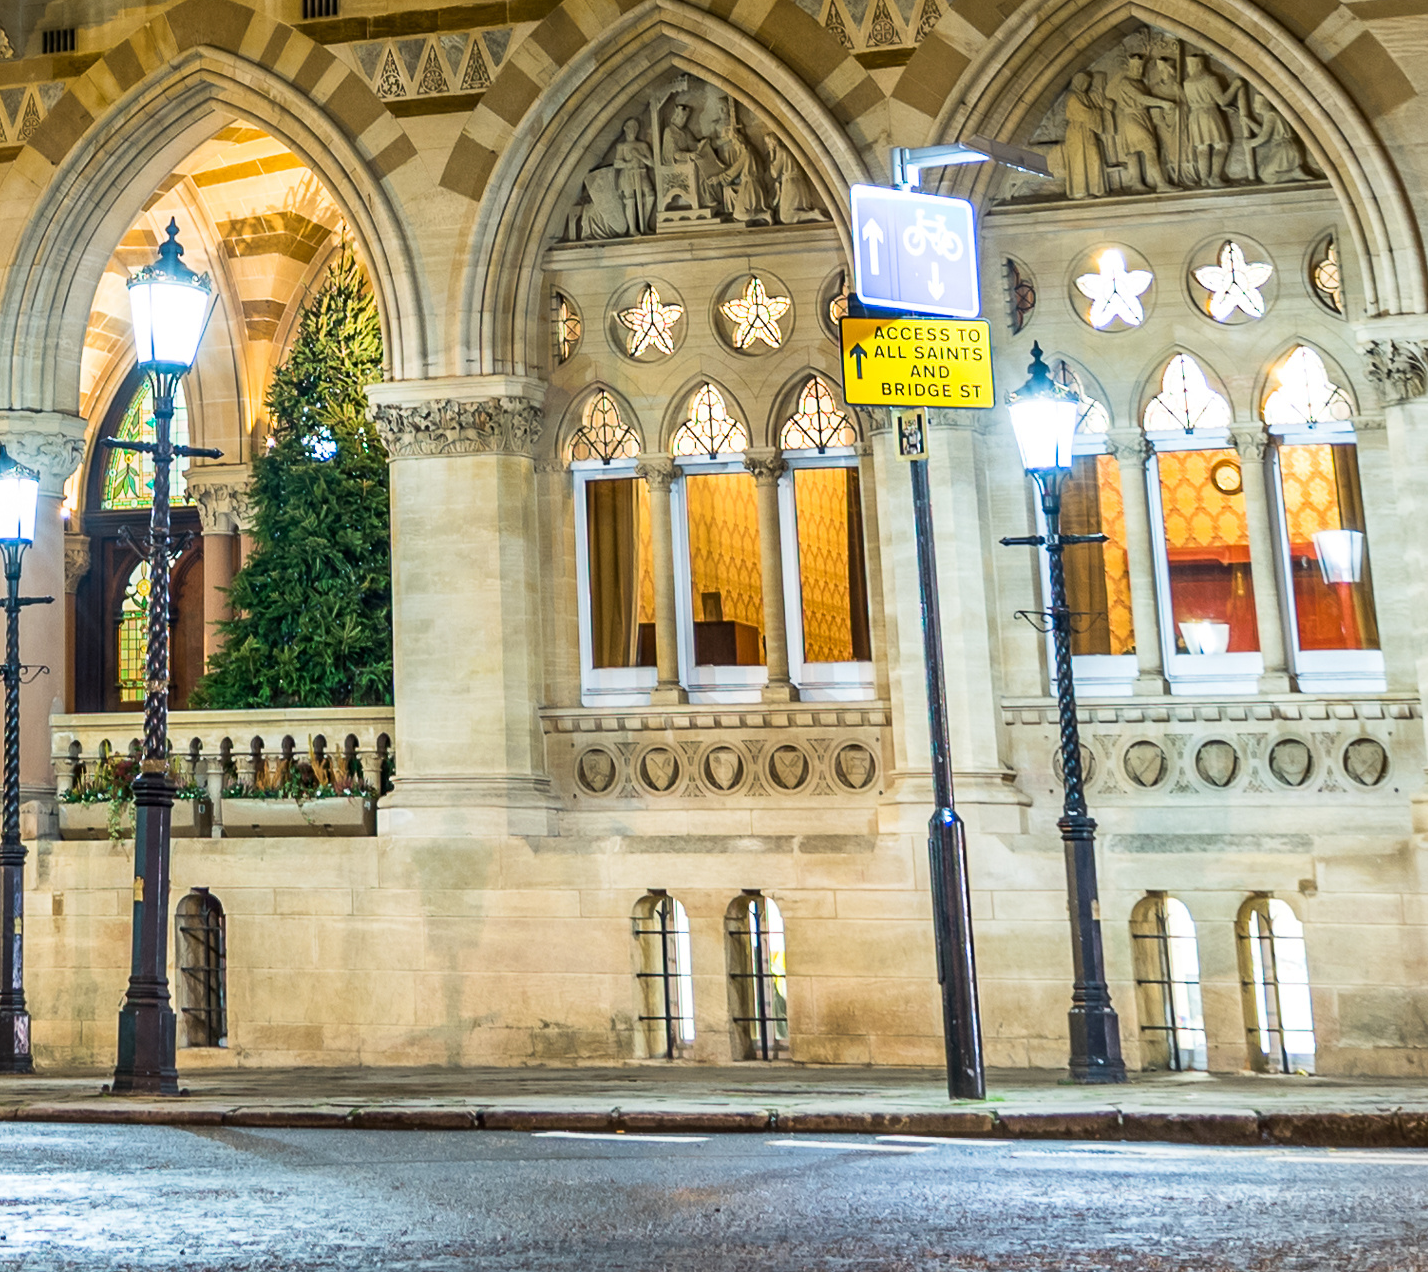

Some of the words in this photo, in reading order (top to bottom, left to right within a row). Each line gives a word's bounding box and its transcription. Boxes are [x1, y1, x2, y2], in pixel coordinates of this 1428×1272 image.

[874, 326, 950, 341] ACCESS
[957, 329, 981, 343] TO
[874, 345, 907, 359] ALL
[914, 346, 983, 361] SAINTS
[910, 364, 950, 379] AND
[882, 382, 952, 398] BRIDGE
[960, 384, 981, 398] ST
